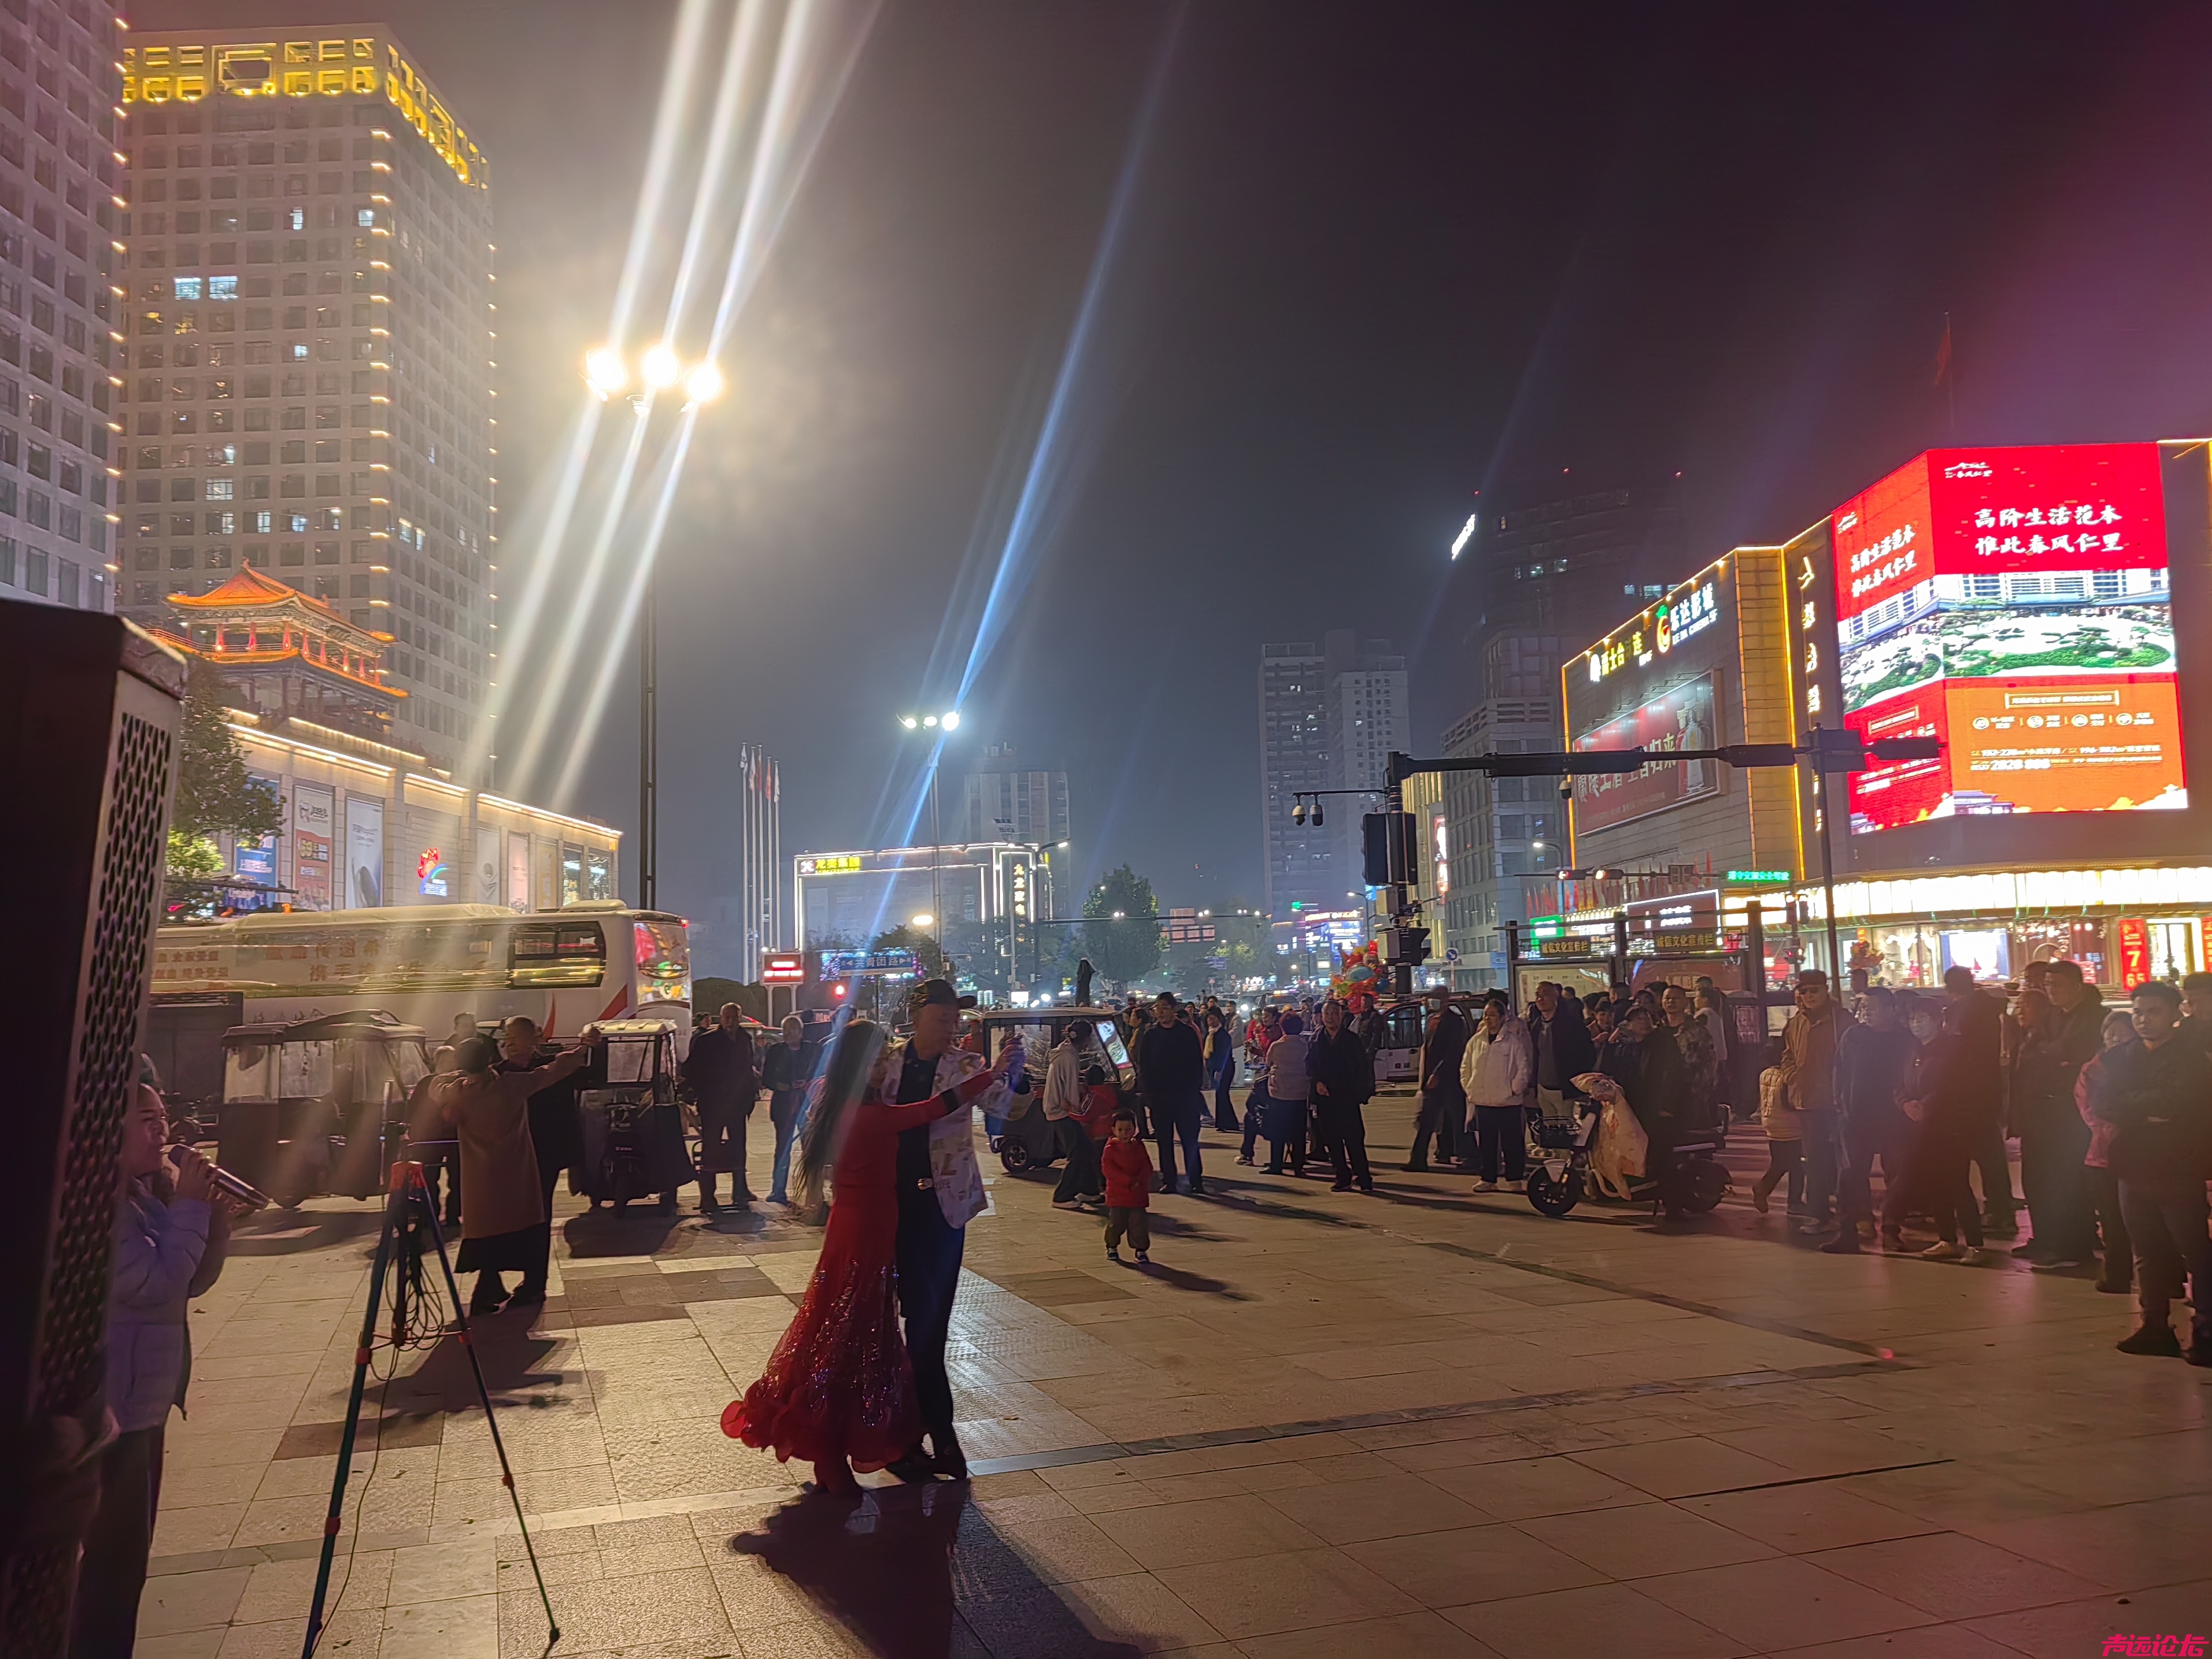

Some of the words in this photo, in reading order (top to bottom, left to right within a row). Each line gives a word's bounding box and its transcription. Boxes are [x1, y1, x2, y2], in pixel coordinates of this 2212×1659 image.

[1974, 504, 2122, 528] 高阶生活范本
[1974, 532, 2124, 556] 惟此春风仁里
[1656, 933, 1714, 948] 诚信文化宣传栏
[2127, 950, 2141, 967] 7
